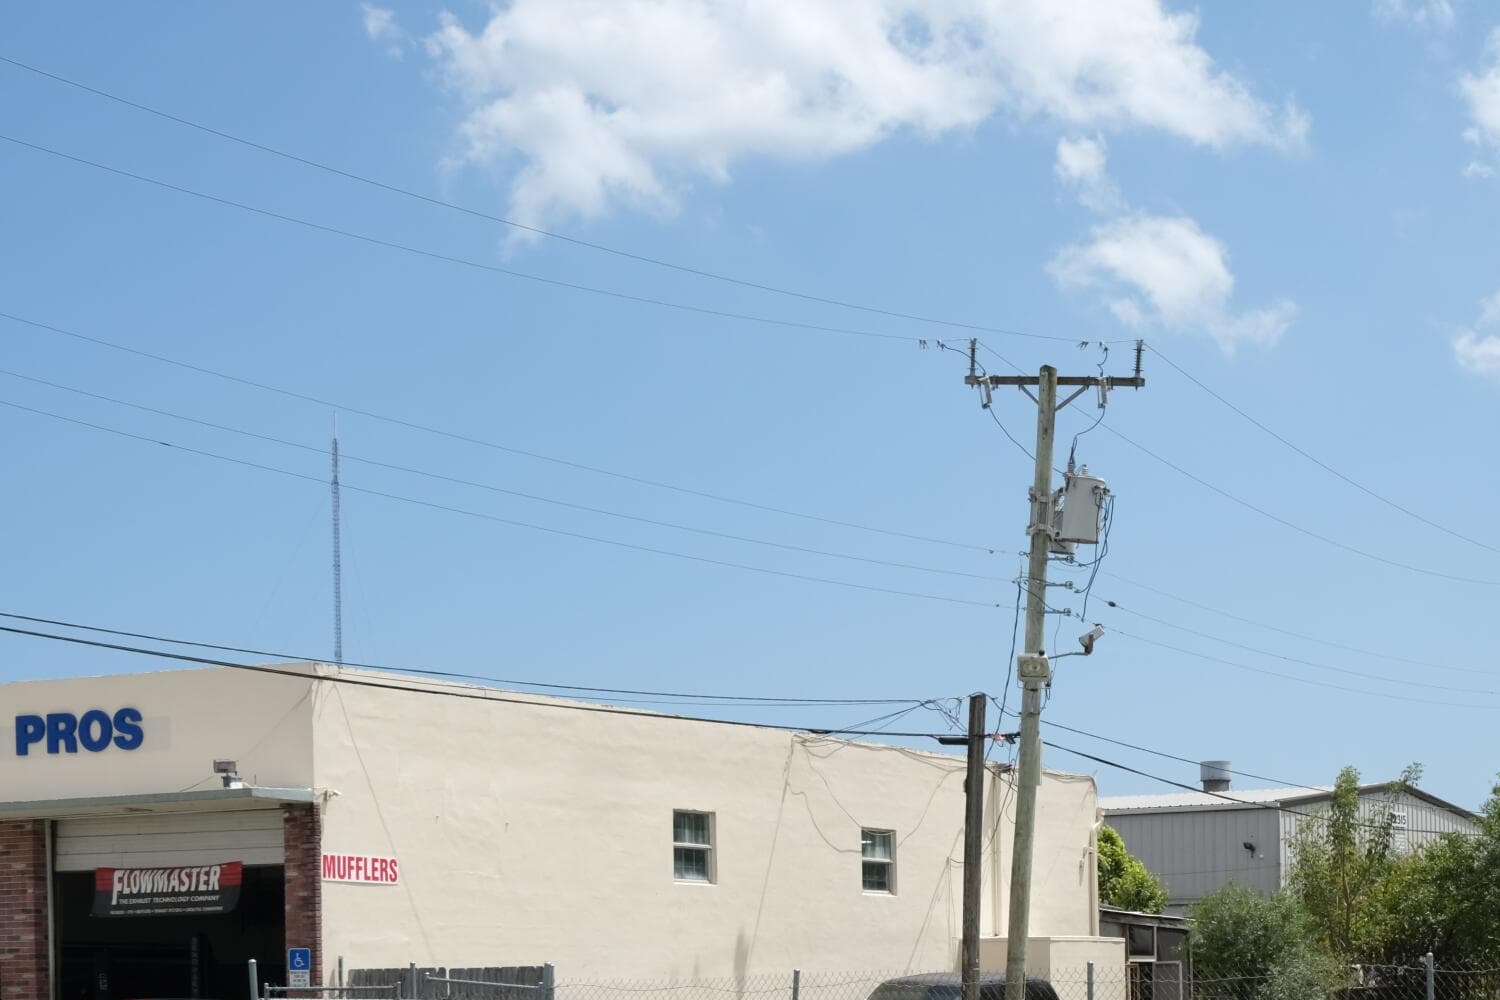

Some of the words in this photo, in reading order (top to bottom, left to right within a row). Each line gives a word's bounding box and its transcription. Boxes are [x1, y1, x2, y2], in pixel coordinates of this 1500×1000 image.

[16, 708, 144, 755] PROS
[111, 866, 221, 905] FLOWMASTER
[322, 855, 398, 883] MUFFLERS
